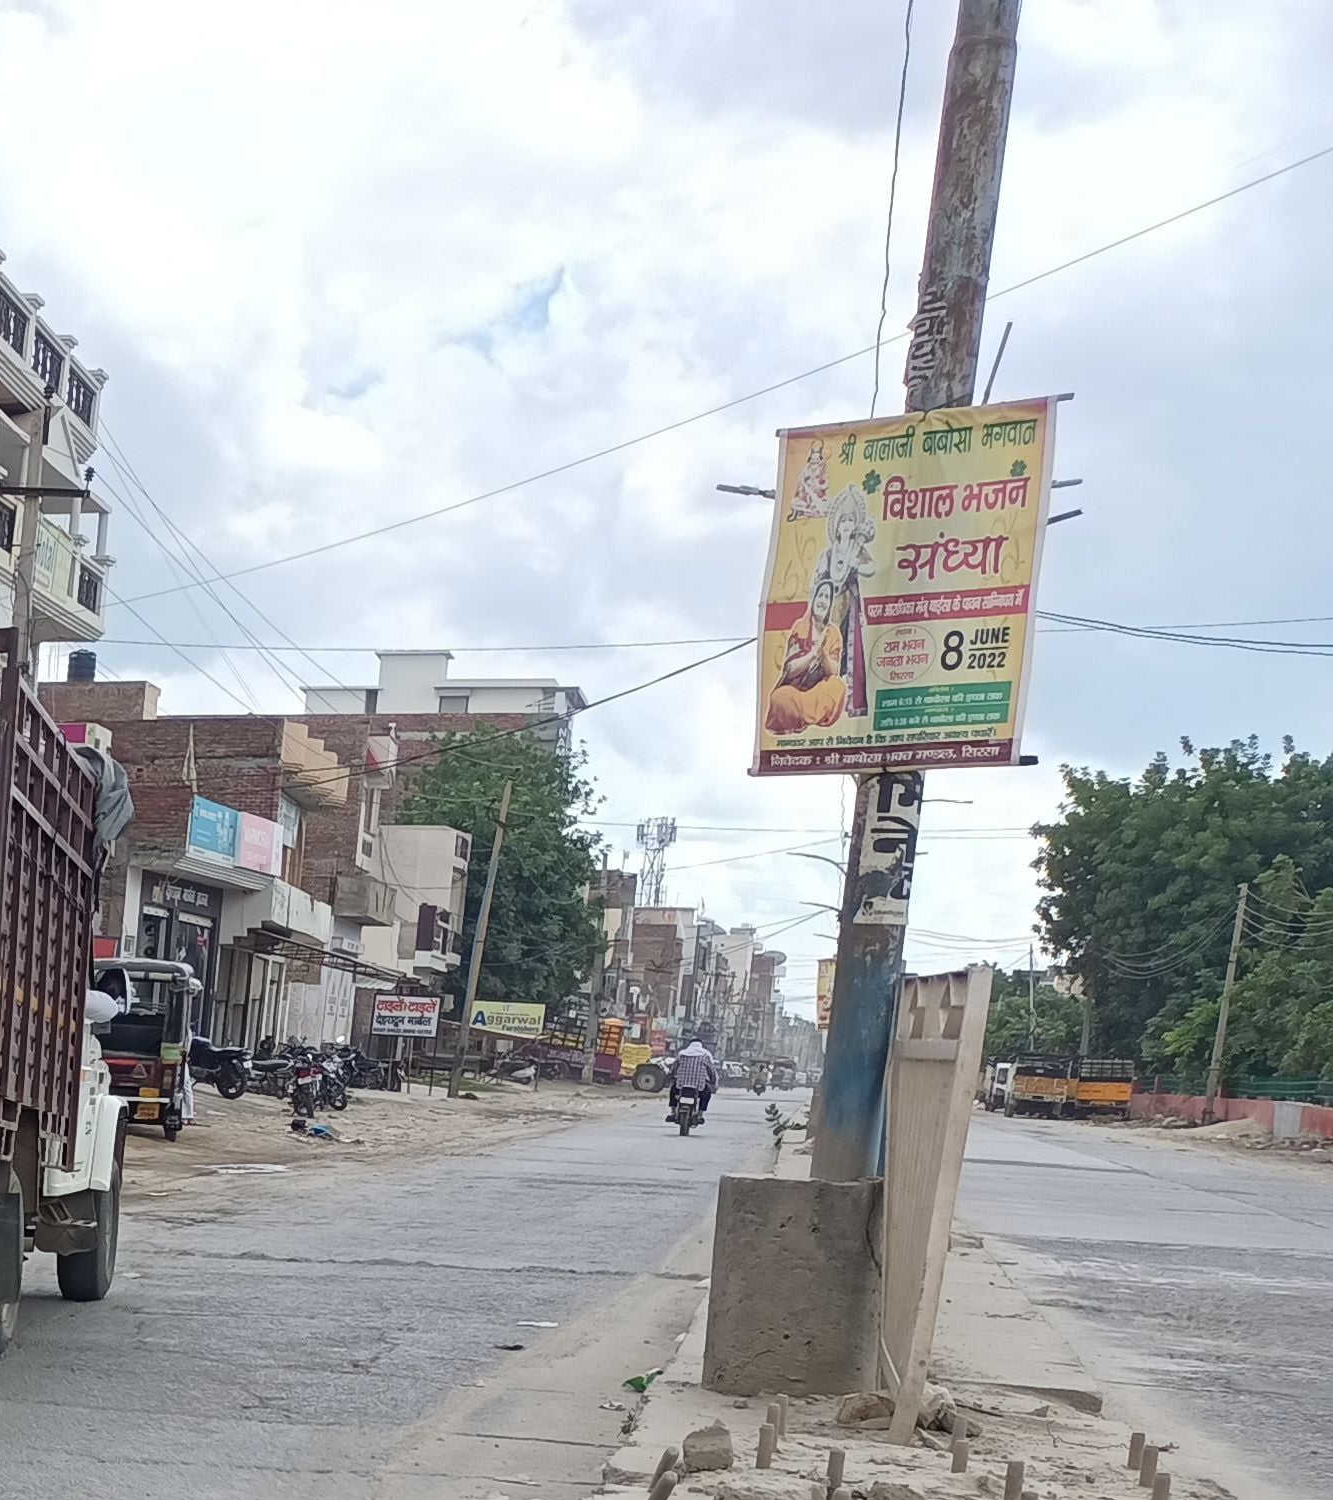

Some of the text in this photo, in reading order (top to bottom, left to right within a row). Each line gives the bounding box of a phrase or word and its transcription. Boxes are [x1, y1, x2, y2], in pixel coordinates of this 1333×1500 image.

[839, 419, 1038, 465] श्री बालाजी बाबोसा भगवान
[883, 476, 1031, 521] विशाल भजन
[896, 532, 1009, 581] संध्या
[940, 627, 1010, 671] 8 JUNE
[966, 651, 1007, 670] 2022
[961, 744, 1000, 758] सिरसा
[472, 1010, 541, 1027] Aggarwal
